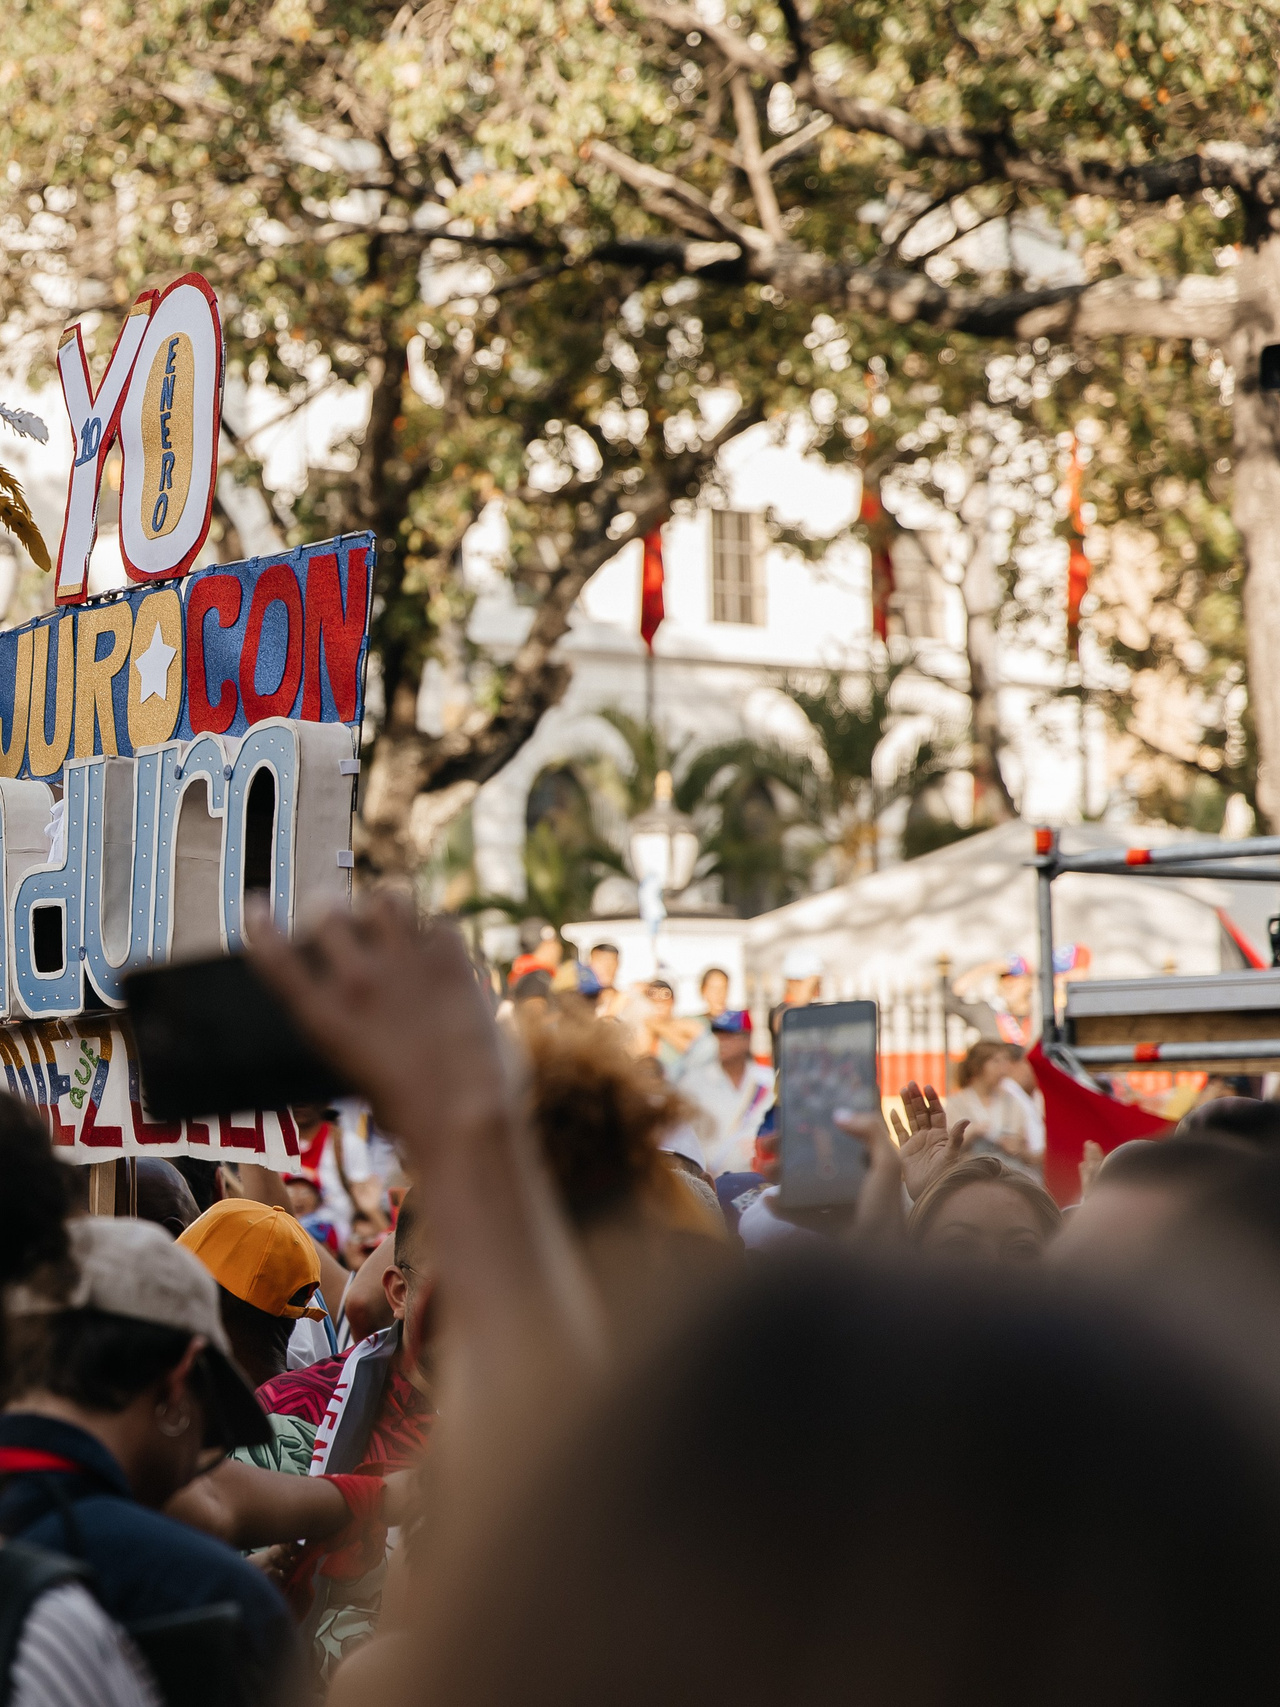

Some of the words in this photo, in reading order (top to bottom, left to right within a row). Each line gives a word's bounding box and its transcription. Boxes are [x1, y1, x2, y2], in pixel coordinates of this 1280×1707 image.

[55, 272, 222, 606] YO
[74, 417, 102, 467] 10
[151, 337, 180, 533] ENERO
[185, 546, 370, 736] CON
